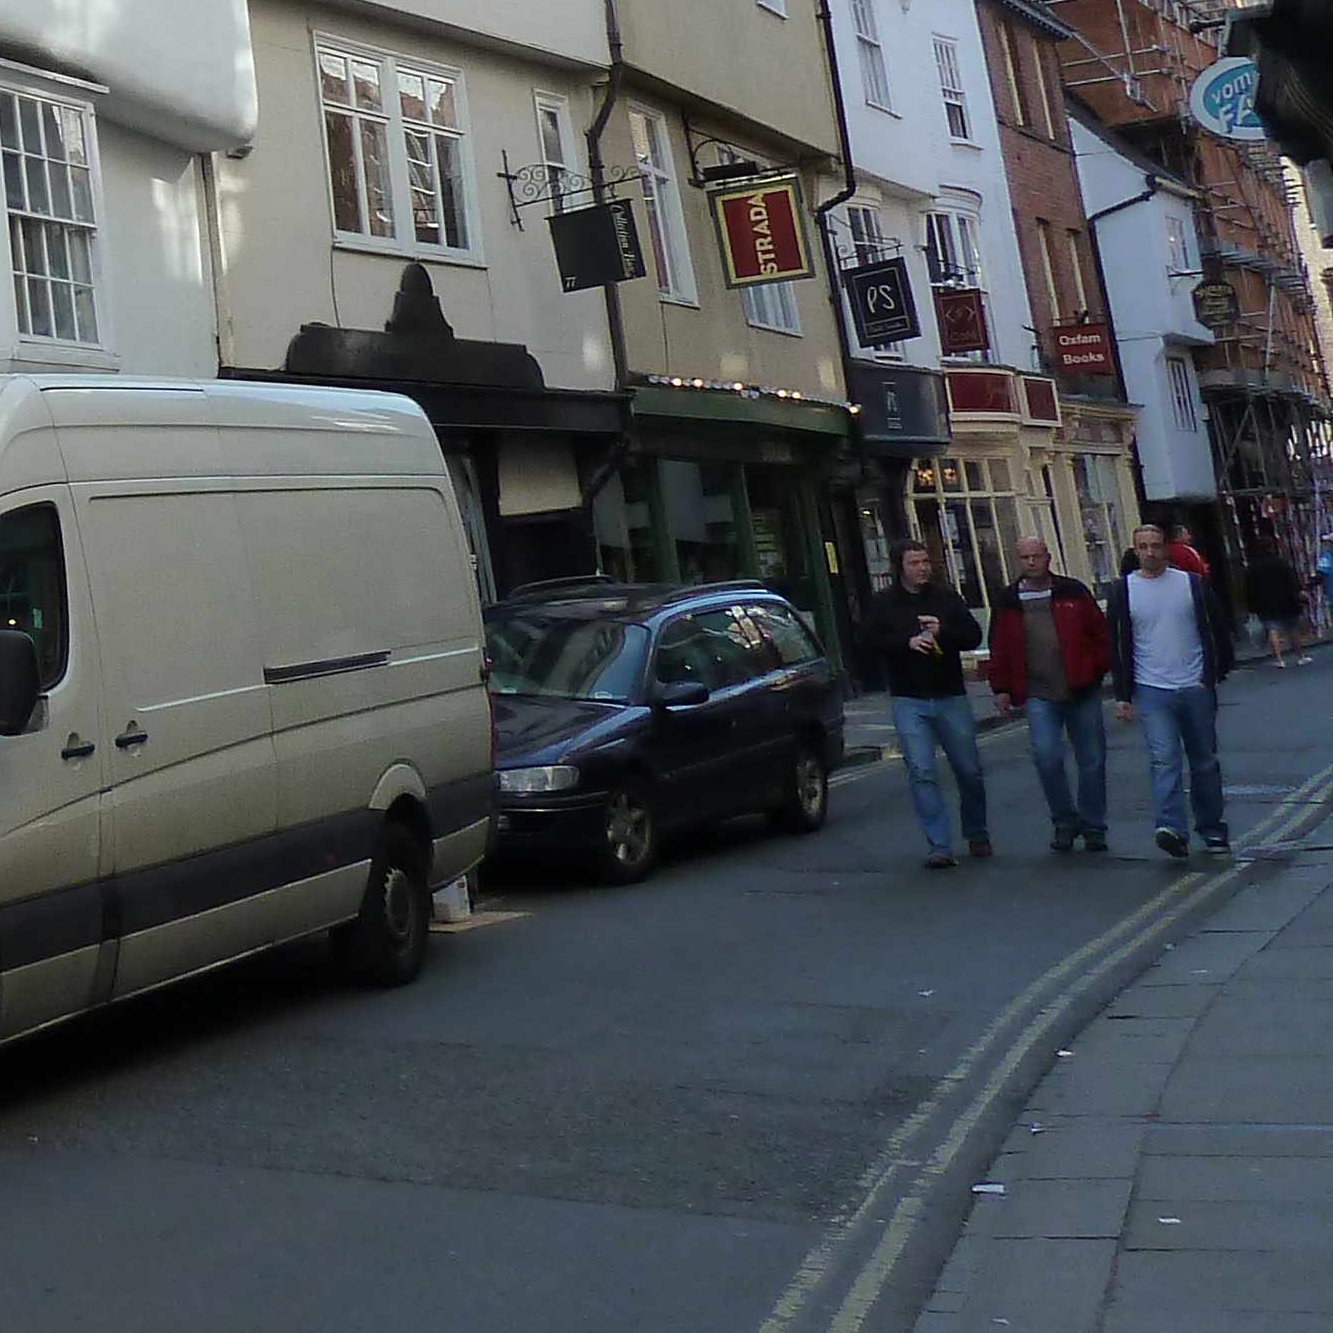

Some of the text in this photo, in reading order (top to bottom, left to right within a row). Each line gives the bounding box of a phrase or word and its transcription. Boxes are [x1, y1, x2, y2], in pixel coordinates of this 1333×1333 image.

[1211, 72, 1253, 104] vom
[747, 193, 778, 274] STRADA
[867, 285, 895, 314] PS
[1059, 334, 1101, 346] Oxfam
[1063, 352, 1105, 365] Books
